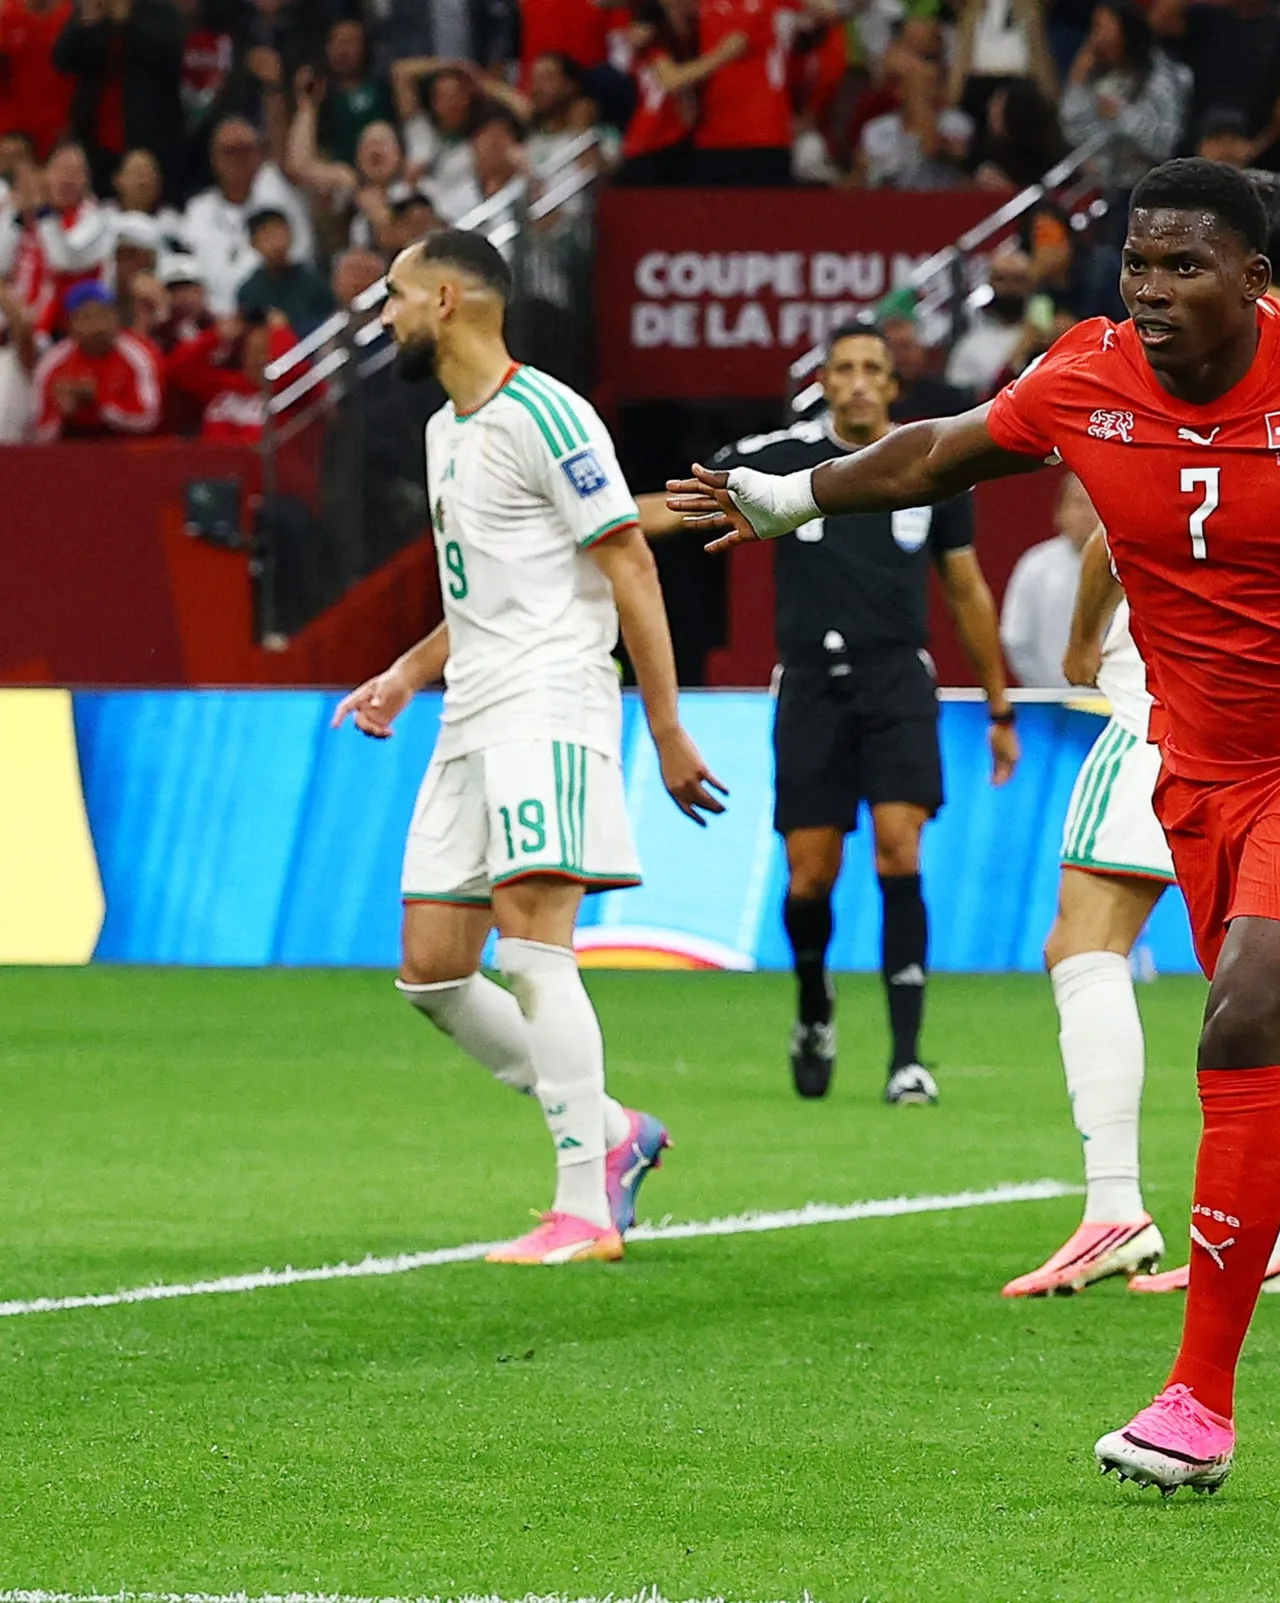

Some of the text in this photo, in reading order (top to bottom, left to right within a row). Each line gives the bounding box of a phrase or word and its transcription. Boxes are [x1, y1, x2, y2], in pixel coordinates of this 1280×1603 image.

[634, 252, 805, 297] COUPE
[811, 252, 884, 297] DU
[631, 302, 697, 348] DE
[705, 302, 773, 347] LA
[1180, 467, 1221, 560] 7
[446, 541, 468, 599] 9
[499, 799, 545, 860] 19
[1191, 1203, 1240, 1228] uisse
